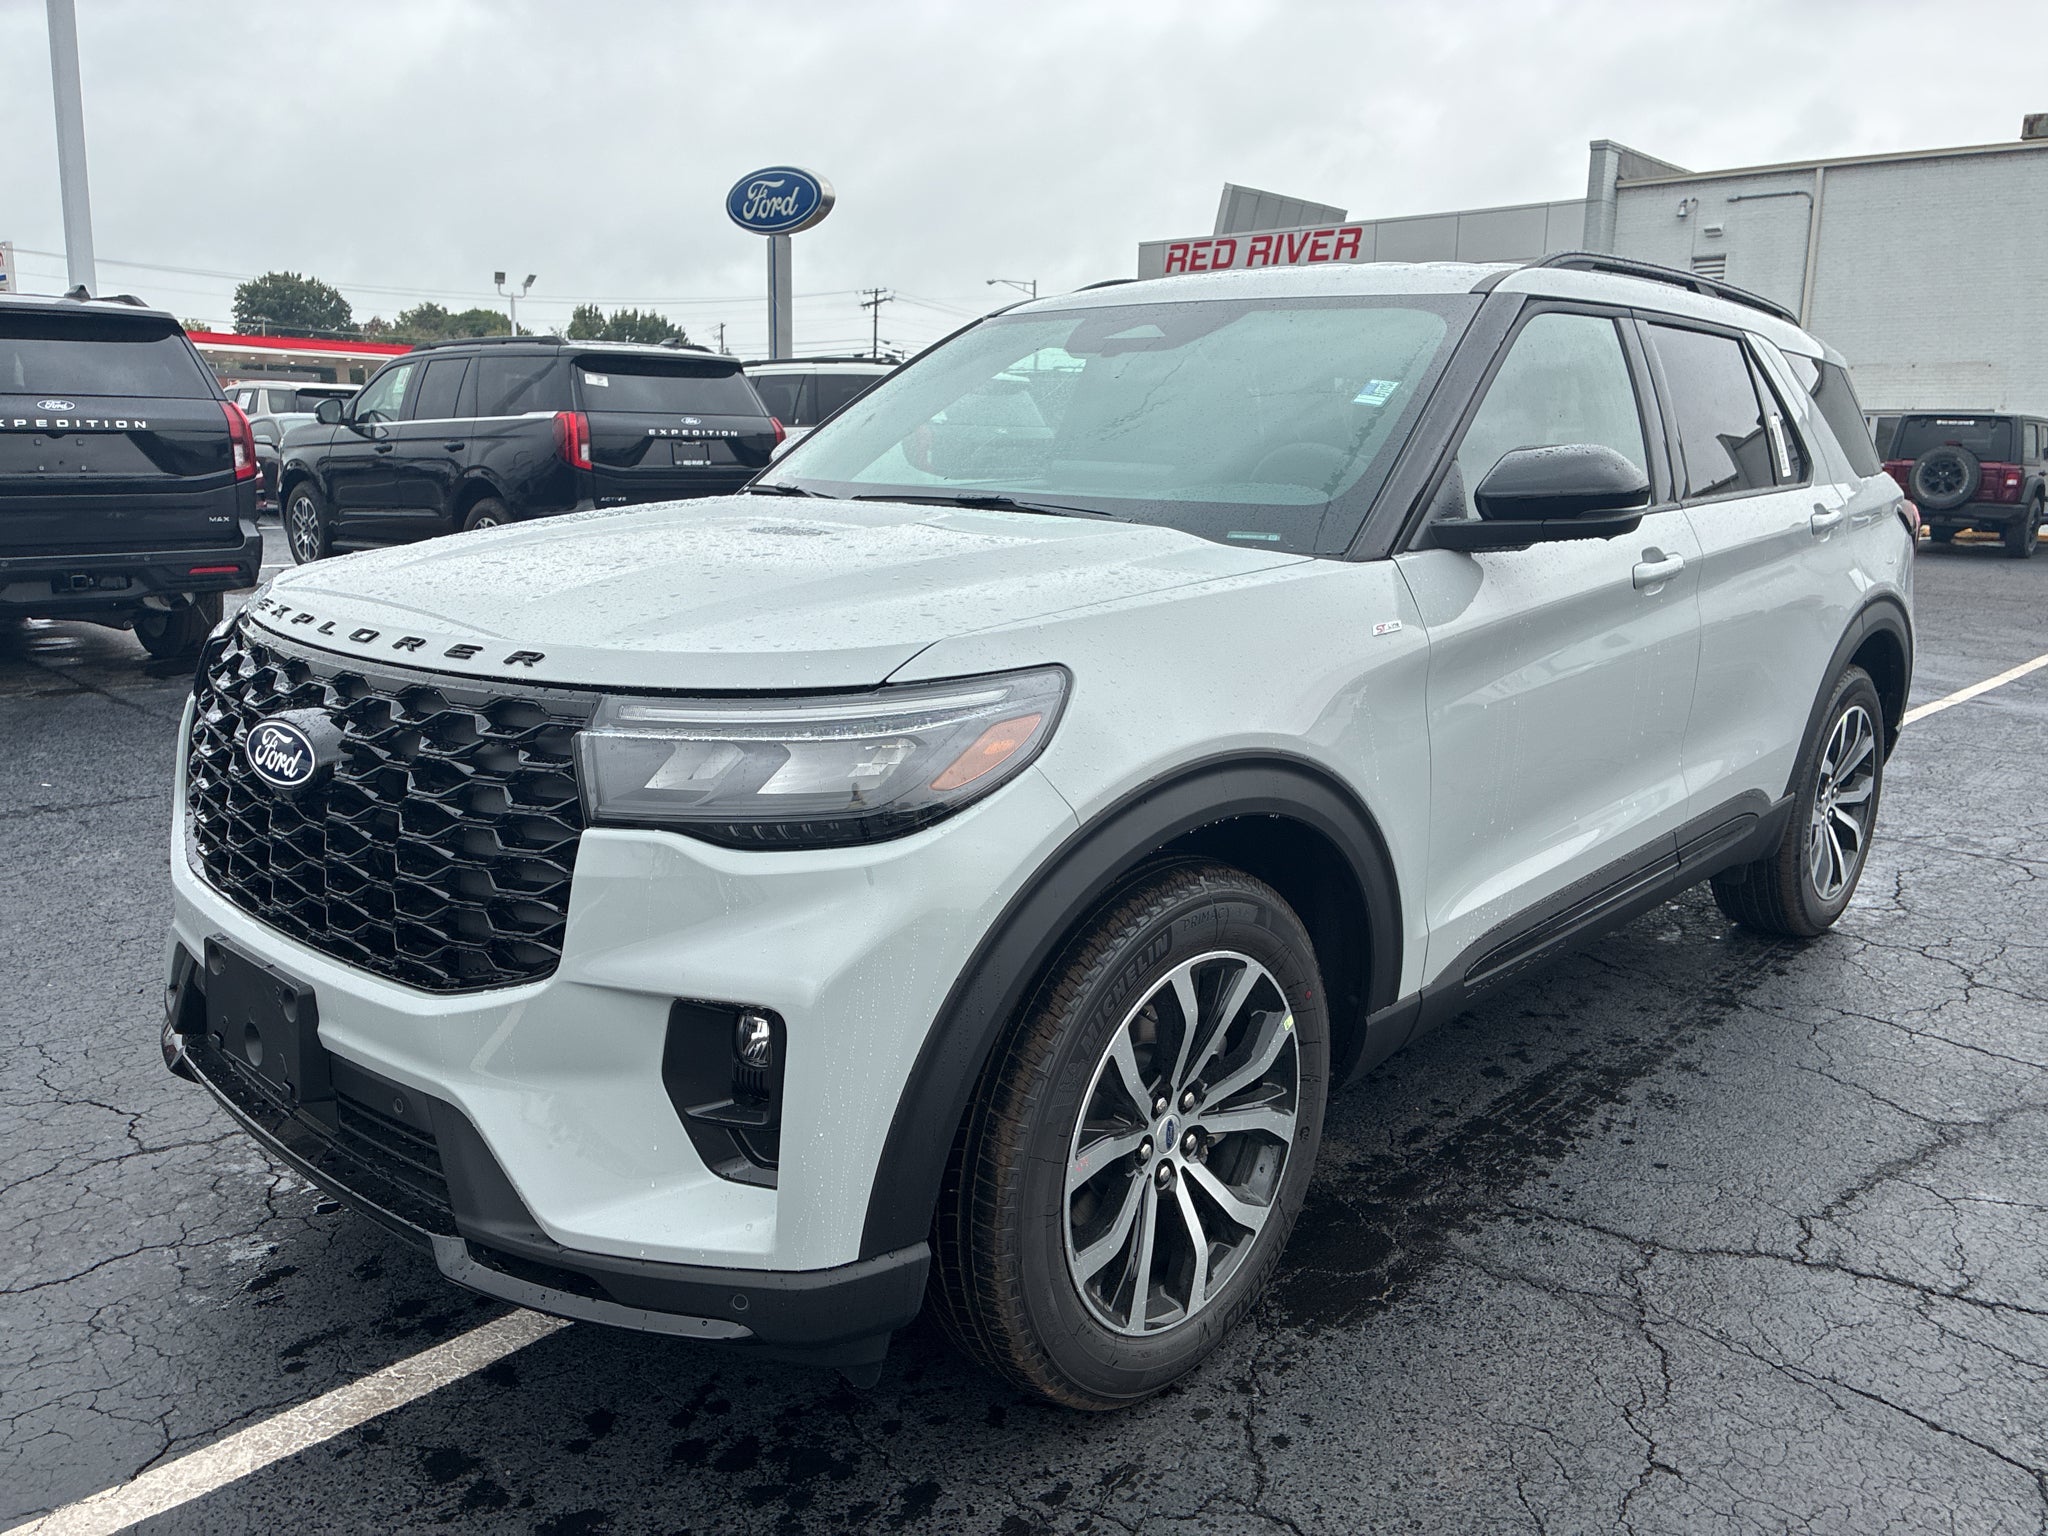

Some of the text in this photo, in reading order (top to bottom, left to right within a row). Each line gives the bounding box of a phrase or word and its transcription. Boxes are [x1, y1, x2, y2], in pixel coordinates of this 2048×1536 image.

[743, 179, 800, 220] Ford
[1164, 226, 1364, 273] RED RIVER
[648, 428, 738, 437] EXPEDITION
[256, 598, 547, 668] EXPLORER
[255, 728, 303, 778] Ford
[1080, 932, 1170, 1050] MICHELIN
